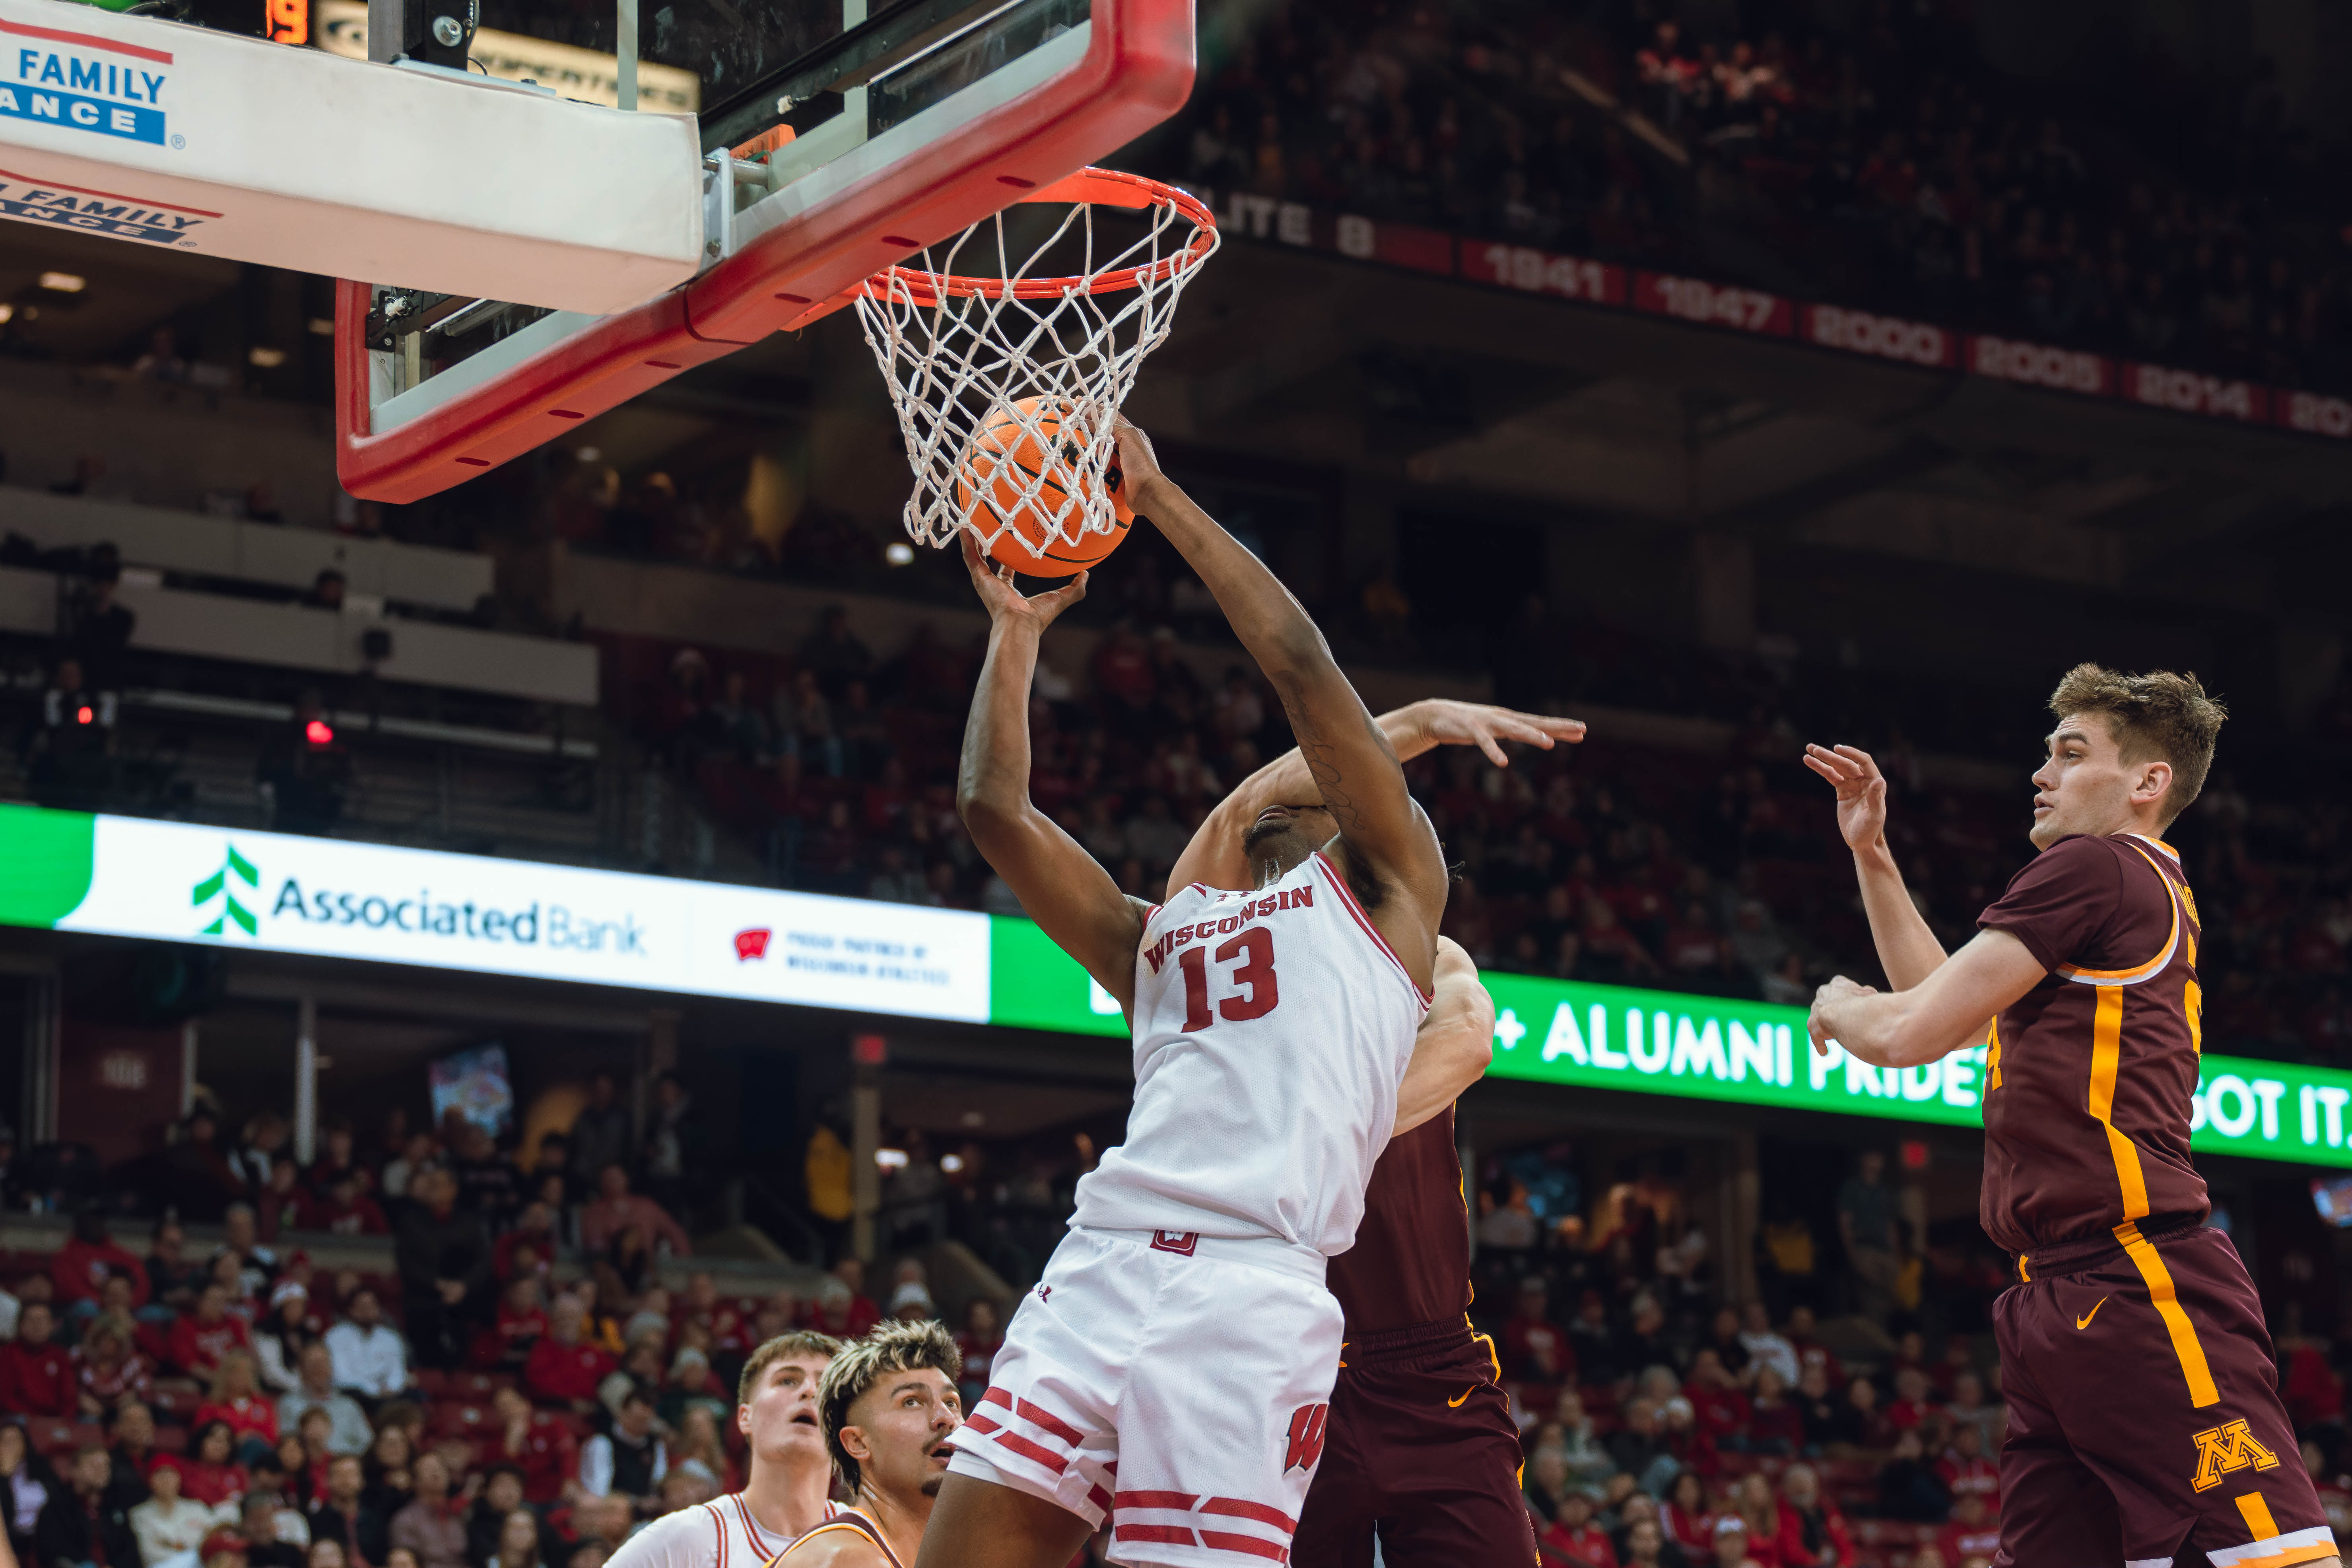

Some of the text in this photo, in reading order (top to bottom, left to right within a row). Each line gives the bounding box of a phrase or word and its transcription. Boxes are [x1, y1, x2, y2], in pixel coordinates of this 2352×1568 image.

[20, 49, 167, 104] FAMILY
[21, 190, 203, 230] FAMILY
[1484, 243, 1605, 302] 1941
[1657, 274, 1776, 331] 1947
[1812, 303, 1946, 365] 2000
[1144, 885, 1313, 974] WISCONSIN
[1179, 926, 1279, 1033] 13
[1542, 1002, 1792, 1088] ALUMNI
[1808, 1031, 1987, 1107] PRIDE
[2191, 1418, 2280, 1494] M
